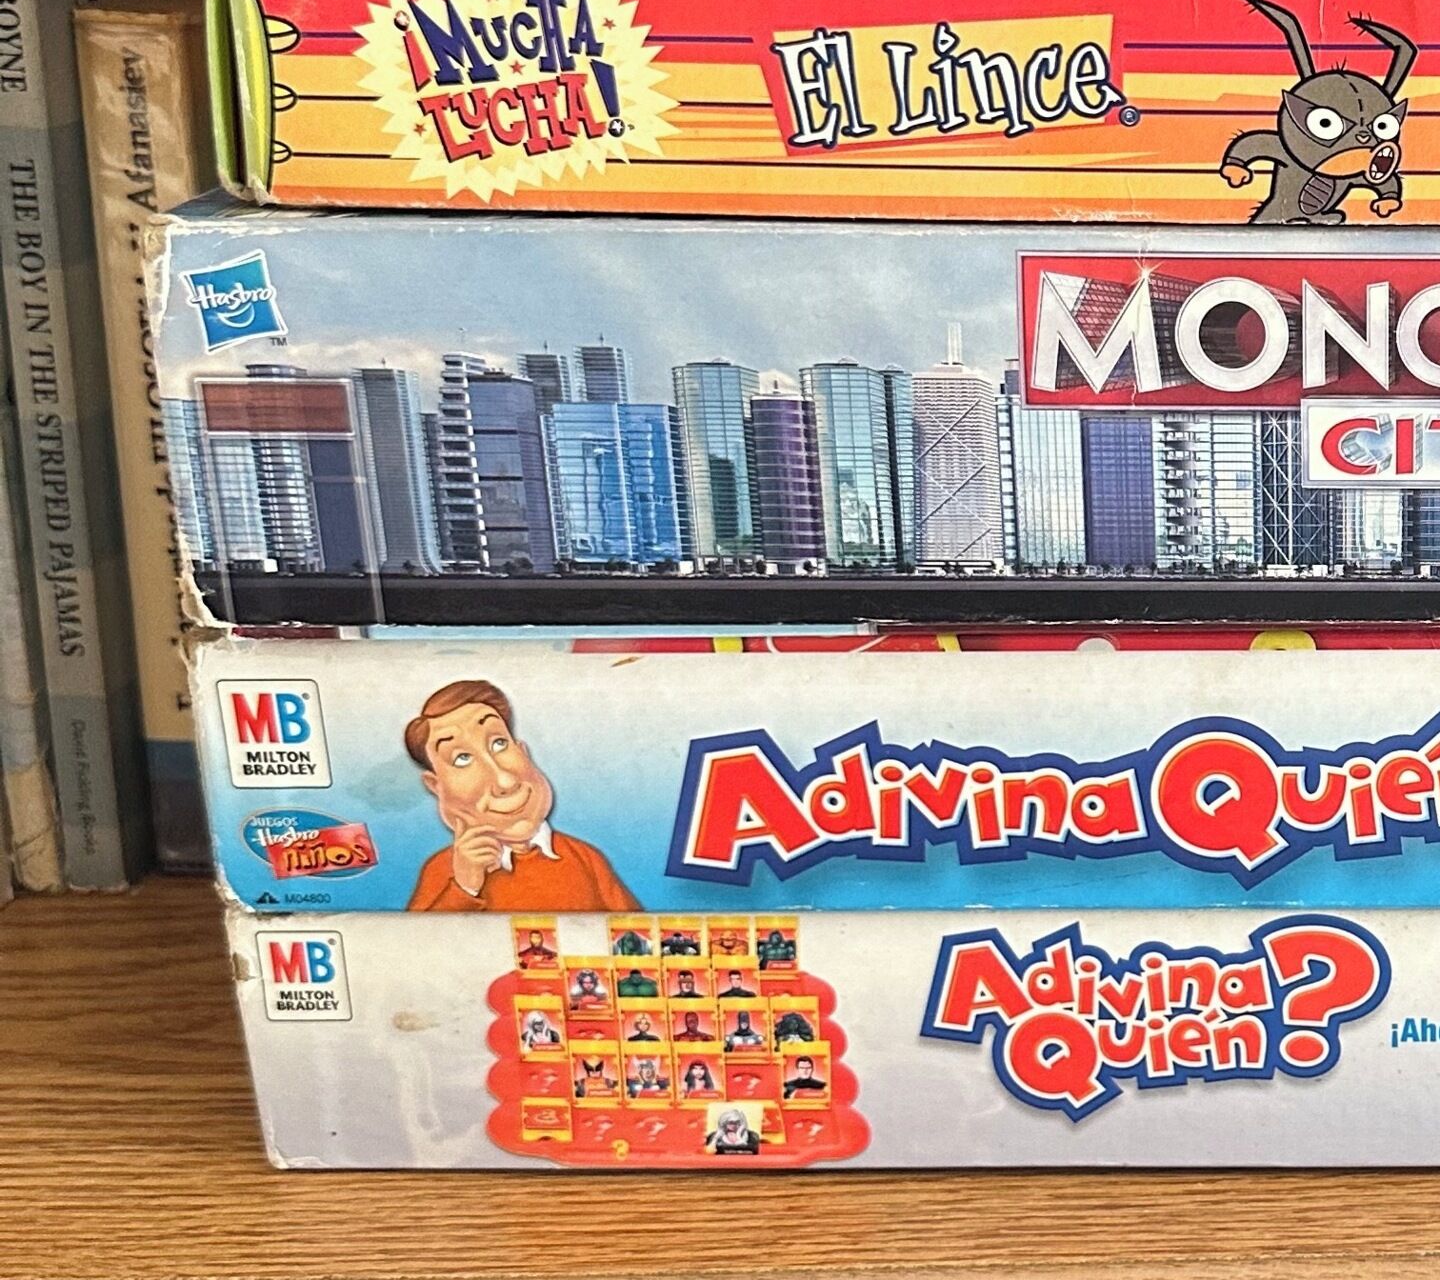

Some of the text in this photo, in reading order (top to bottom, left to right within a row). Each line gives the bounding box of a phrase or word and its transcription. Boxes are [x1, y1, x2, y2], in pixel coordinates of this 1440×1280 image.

[774, 21, 1127, 150] El Lince
[418, 58, 626, 163] LUCHA!
[191, 282, 274, 310] Hasbro
[8, 160, 85, 658] THE BOY IN THE STRIPED PAJAMAS
[231, 692, 311, 744] MB
[243, 763, 317, 776] BRADLEY
[246, 751, 311, 763] MILTON
[682, 740, 1149, 872] Adivina
[269, 941, 336, 983] MB
[933, 937, 1274, 1032] Adivina
[276, 1001, 339, 1011] BRADLEY
[280, 990, 334, 1000] MILTON
